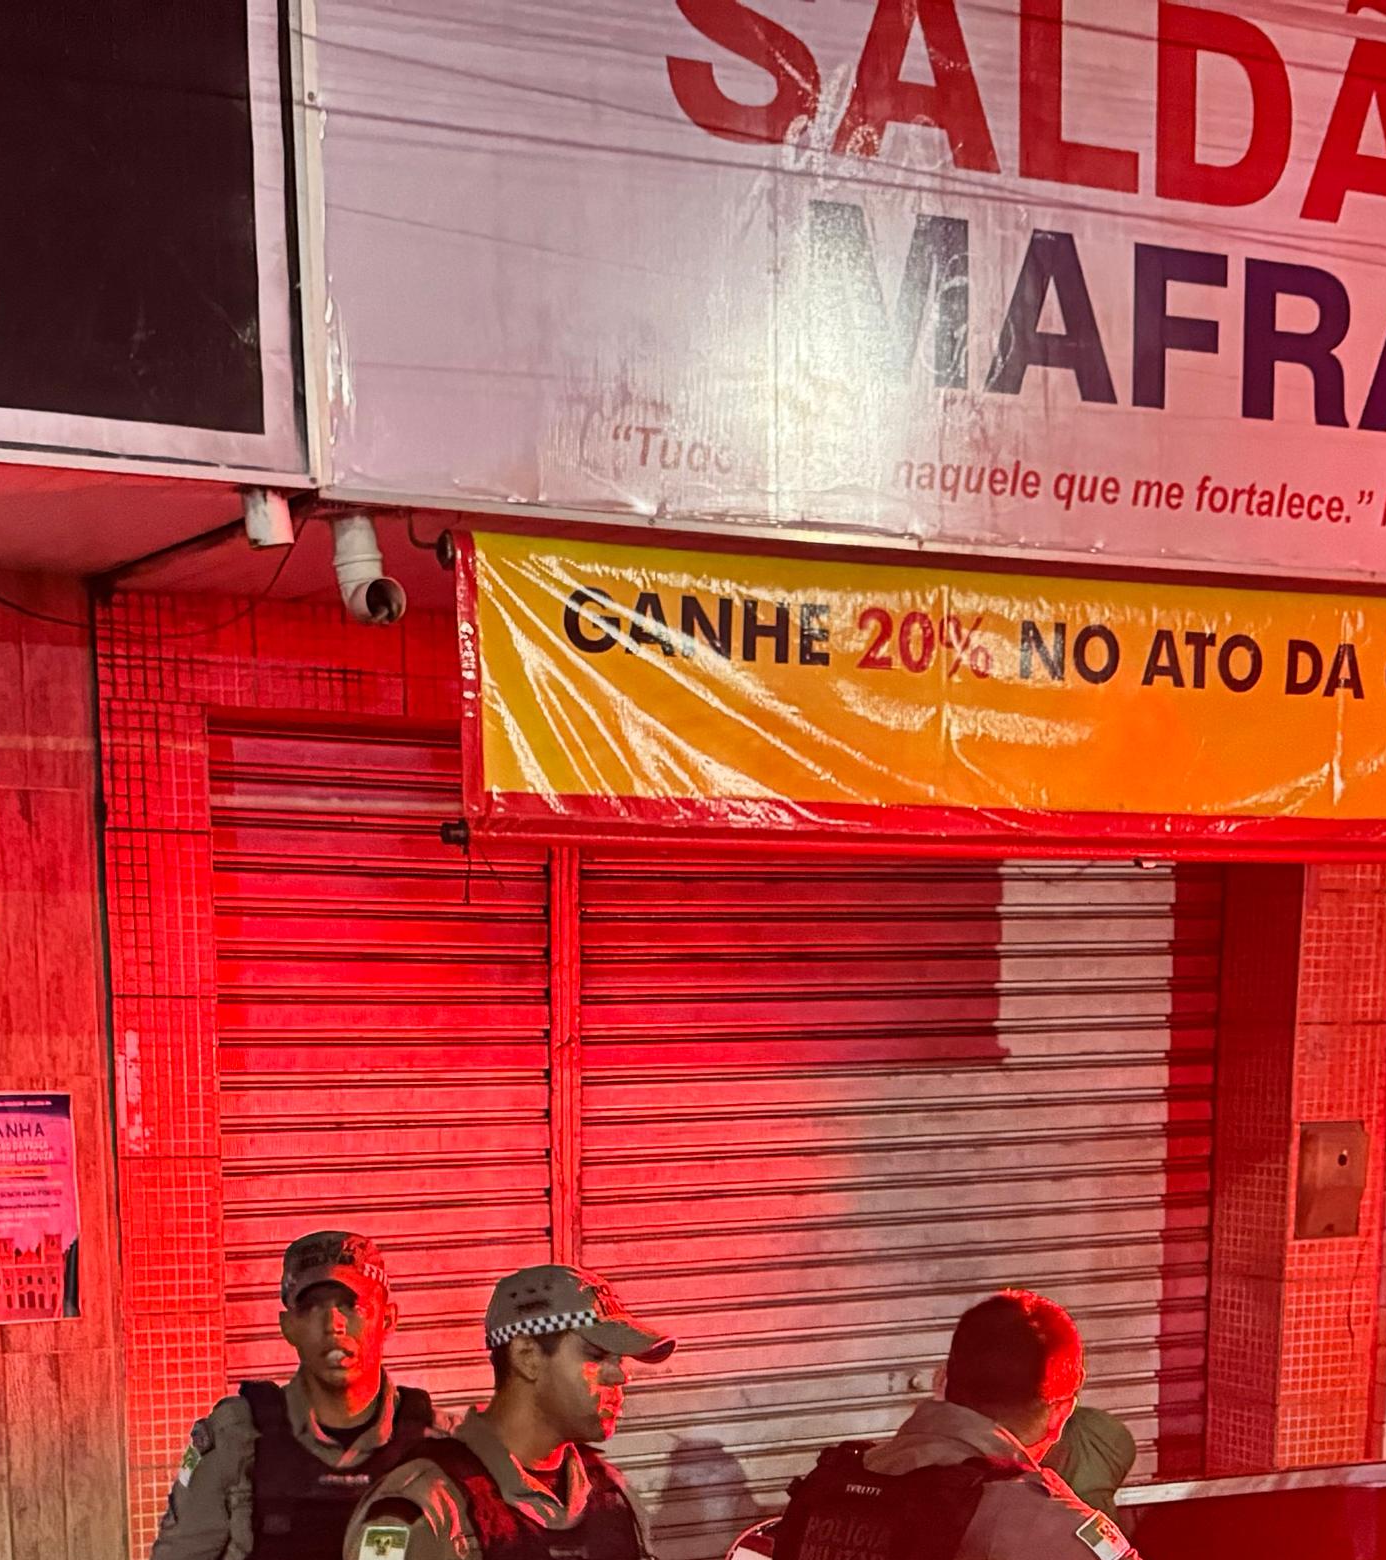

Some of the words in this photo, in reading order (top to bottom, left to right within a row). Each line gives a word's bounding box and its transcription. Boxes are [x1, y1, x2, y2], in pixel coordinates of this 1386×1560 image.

[894, 459, 1043, 505] naquele
[1053, 472, 1121, 512] que
[1132, 480, 1185, 511] me
[563, 586, 832, 666] GANHE
[857, 606, 994, 679] 20%
[1019, 620, 1121, 686] NO
[1142, 629, 1263, 693] ATO
[1284, 639, 1365, 699] DA
